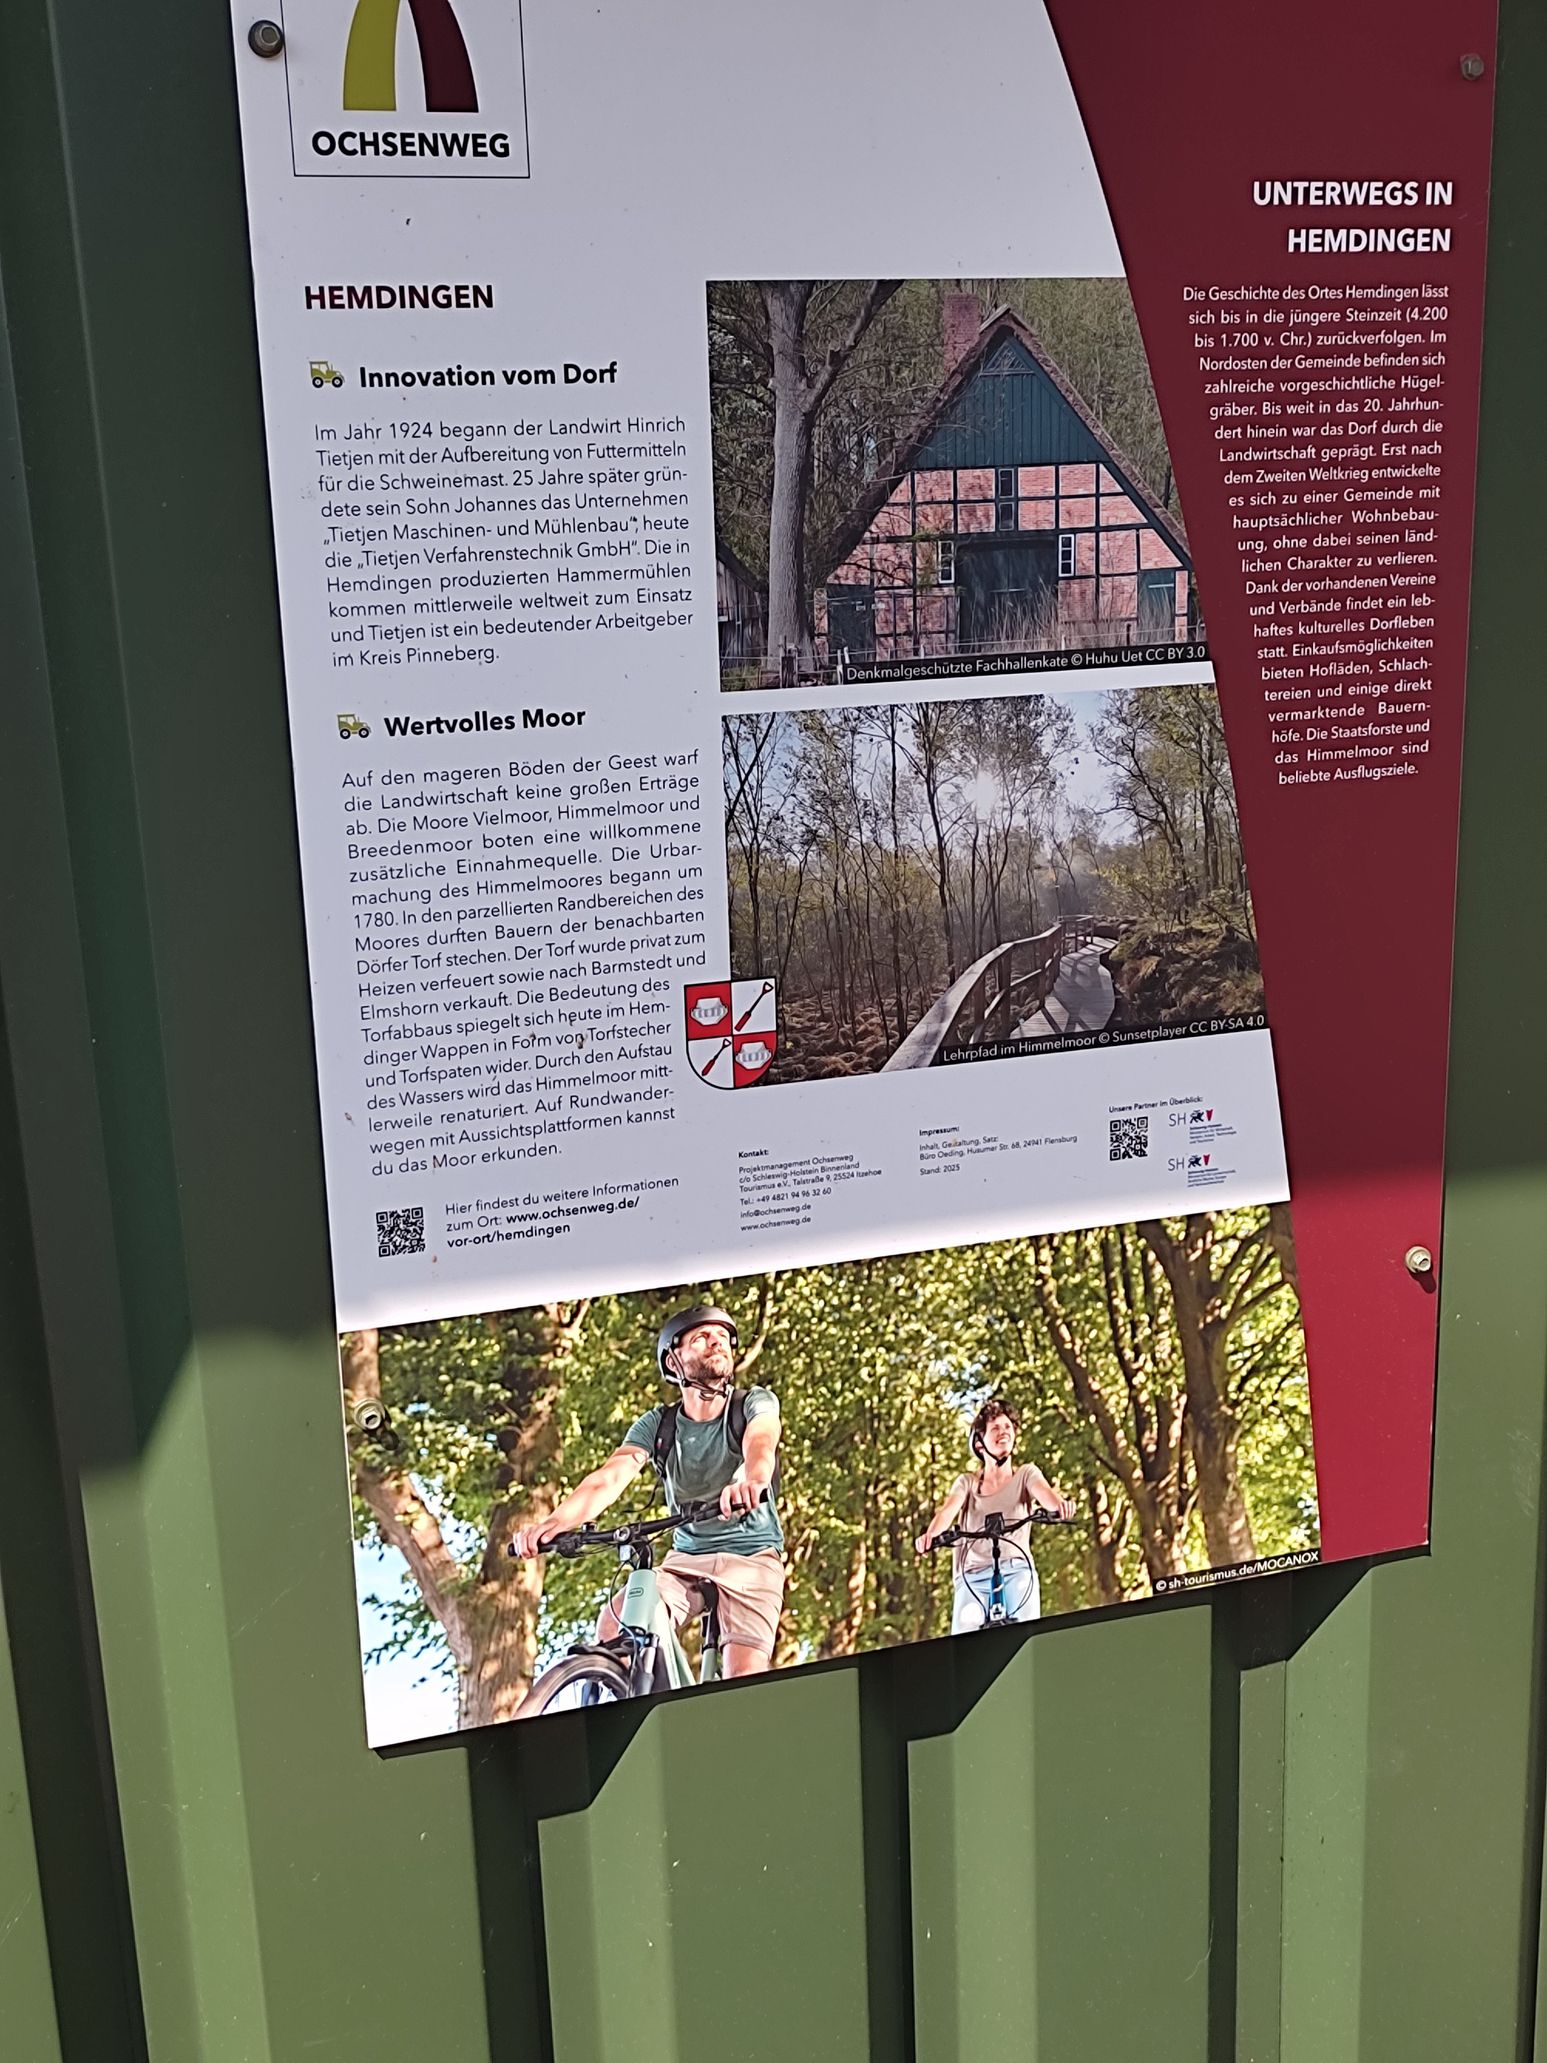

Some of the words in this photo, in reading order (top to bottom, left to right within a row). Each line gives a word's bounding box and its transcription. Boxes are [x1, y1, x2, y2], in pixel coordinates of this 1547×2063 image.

[311, 130, 510, 158] OCHSENWEG
[1253, 181, 1419, 206] UNTERWEGS
[1425, 181, 1453, 206] IN
[1288, 227, 1451, 253] HEMDINGEN
[304, 284, 494, 310] HEMDINGEN
[1183, 286, 1206, 301] Die
[1208, 285, 1280, 301] Geschichte
[1282, 284, 1306, 300] des
[1307, 284, 1343, 300] Ortes
[1345, 283, 1419, 302] Hemdingen
[1421, 283, 1449, 298] lässt
[1199, 355, 1268, 371] Nordosten
[1270, 354, 1293, 370] der
[1294, 353, 1362, 369] Gemeinde
[1363, 351, 1419, 367] befinden
[1421, 351, 1446, 366] sich
[359, 364, 496, 388] Innovation
[501, 369, 556, 386] vom
[563, 361, 618, 385] Dorf
[1204, 378, 1275, 394] zahlreiche
[1279, 375, 1396, 396] vorgeschichtliche
[1400, 373, 1445, 392] Hügel-
[315, 424, 337, 441] Im
[343, 422, 382, 441] Jahr
[389, 421, 433, 439] 1924
[439, 420, 507, 442] begann
[513, 418, 543, 436] der
[549, 417, 622, 435] Landwirt
[627, 415, 686, 433] Hinrich
[315, 449, 374, 471] Tietjen
[378, 448, 406, 465] mit
[409, 446, 438, 464] der
[440, 445, 549, 465] Aufbereitung
[552, 447, 583, 460] von
[587, 439, 686, 459] Futtermitteln
[318, 474, 343, 492] für
[347, 473, 375, 492] die
[379, 472, 509, 491] Schweinemast.
[512, 469, 534, 487] 25
[537, 468, 584, 486] Jahre
[588, 467, 640, 488] später
[644, 466, 688, 487] grün-
[1233, 511, 1343, 532] hauptsächlicher
[1351, 507, 1439, 524] Wohnbebau-
[1241, 557, 1282, 573] lichen
[1287, 554, 1353, 571] Charakter
[1356, 557, 1372, 567] zu
[1377, 550, 1438, 566] verlieren.
[328, 601, 406, 618] kommen
[413, 593, 513, 614] mittlerweile
[519, 591, 589, 609] weltweit
[595, 593, 630, 606] zum
[636, 587, 693, 604] Einsatz
[332, 652, 354, 667] im
[359, 649, 402, 666] Kreis
[406, 644, 500, 666] Pinneberg.
[846, 661, 973, 681] Denkmalgeschützte
[976, 654, 1069, 672] Fachhallenkate
[1085, 651, 1118, 665] Huhu
[1121, 650, 1143, 663] Uet
[1145, 647, 1165, 661] CC
[1167, 647, 1184, 660] BY
[1186, 645, 1206, 659] 3.0
[1261, 666, 1304, 681] bieten
[1309, 661, 1373, 677] Hofläden,
[1378, 656, 1433, 673] Schlach-
[383, 710, 516, 737] Wertvolles
[522, 708, 586, 729] Moor
[1268, 703, 1365, 722] vermarktende
[1378, 701, 1431, 715] Bauern-
[1274, 750, 1299, 765] das
[1307, 744, 1394, 762] Himmelmoor
[1401, 739, 1429, 755] sind
[341, 769, 373, 789] Auf
[381, 769, 415, 786] den
[423, 767, 501, 786] mageren
[509, 759, 565, 777] Böden
[572, 756, 602, 773] der
[608, 754, 658, 771] Geest
[663, 748, 699, 766] warf
[1278, 768, 1331, 785] beliebte
[1333, 761, 1419, 781] Ausflugsziele.
[344, 795, 372, 812] die
[381, 784, 509, 810] Landwirtschaft
[515, 784, 562, 800] keine
[569, 777, 631, 801] großen
[639, 774, 699, 793] Erträge
[348, 839, 473, 860] Breedenmoor
[482, 833, 534, 849] boten
[543, 829, 580, 845] eine
[589, 822, 701, 841] willkommene
[943, 1044, 998, 1062] Lehrpfad
[1000, 1045, 1016, 1055] im
[1019, 1036, 1097, 1053] Himmelmoor
[1112, 1025, 1187, 1043] Sunsetplayer
[1189, 1020, 1208, 1034] CC
[1210, 1017, 1245, 1032] BY-SA
[1246, 1014, 1265, 1027] 4.0
[368, 1111, 433, 1132] lerweile
[440, 1103, 529, 1124] renaturiert.
[534, 1095, 563, 1114] Auf
[569, 1085, 674, 1110] Rundwander-
[1169, 1113, 1187, 1127] SH
[371, 1160, 393, 1177] du
[398, 1157, 428, 1173] das
[432, 1153, 477, 1169] Moor
[481, 1142, 562, 1163] erkunden.
[1167, 1158, 1185, 1171] SH
[445, 1203, 473, 1216] Hier
[475, 1196, 520, 1212] findest
[522, 1192, 540, 1206] du
[542, 1189, 589, 1203] weitere
[592, 1177, 679, 1197] Informationen
[446, 1220, 474, 1232] zum
[477, 1215, 502, 1228] Ort:
[505, 1195, 640, 1224] www.ochsenweg.de/
[447, 1224, 571, 1248] vor-ort/hemdingen
[1169, 1551, 1318, 1589] sh-tourismus.de/MOCANOX
